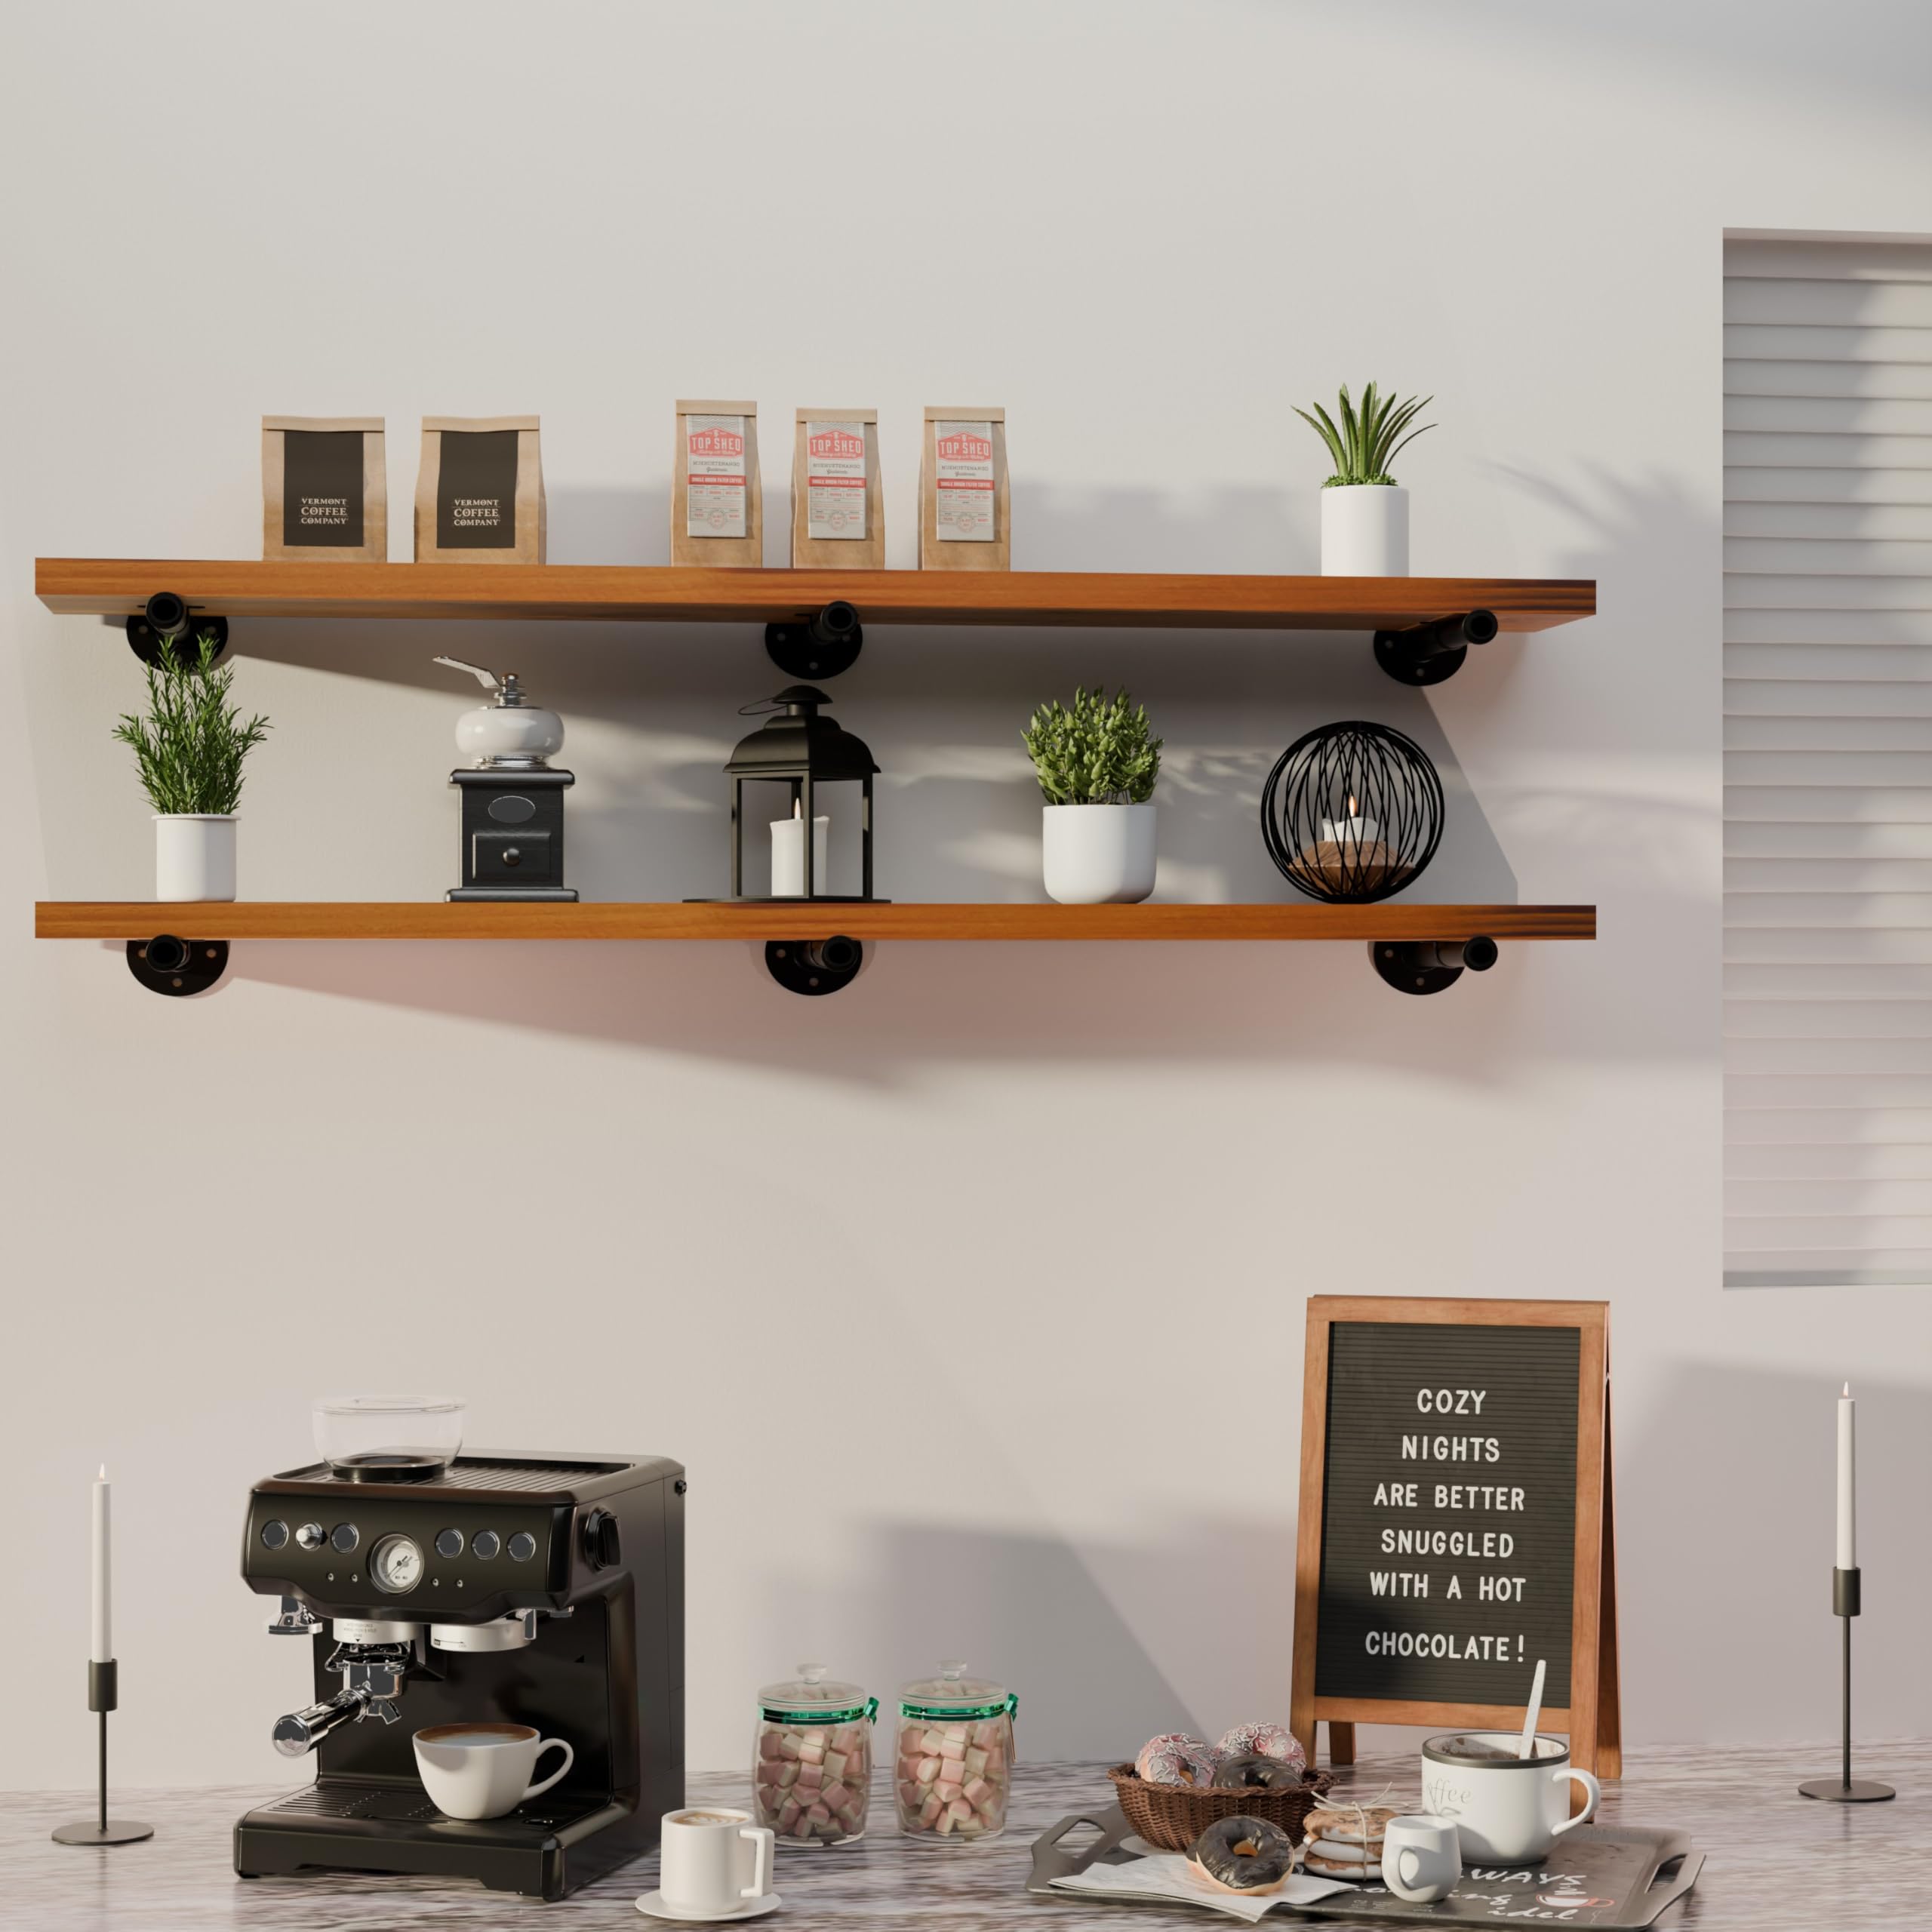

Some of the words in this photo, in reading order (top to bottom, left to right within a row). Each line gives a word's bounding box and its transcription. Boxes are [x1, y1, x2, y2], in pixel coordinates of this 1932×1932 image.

[691, 437, 711, 451] TOP
[714, 438, 741, 451] SHED
[812, 439, 831, 453] TOP
[834, 440, 861, 454] SHED
[940, 441, 959, 454] TOP
[962, 441, 989, 456] SHED
[300, 506, 347, 515] COFFEE
[454, 508, 499, 517] COFFEE
[1417, 1388, 1487, 1415] COZY
[1401, 1435, 1500, 1463] NIGHTS
[1373, 1482, 1419, 1508] ARE
[1434, 1484, 1525, 1511] BETTER
[1381, 1528, 1514, 1558] SNUGGLED
[1369, 1571, 1429, 1598] WITH
[1446, 1575, 1462, 1600] A
[1478, 1576, 1527, 1602] HOT
[1365, 1631, 1524, 1663] CHOCOLATE!
